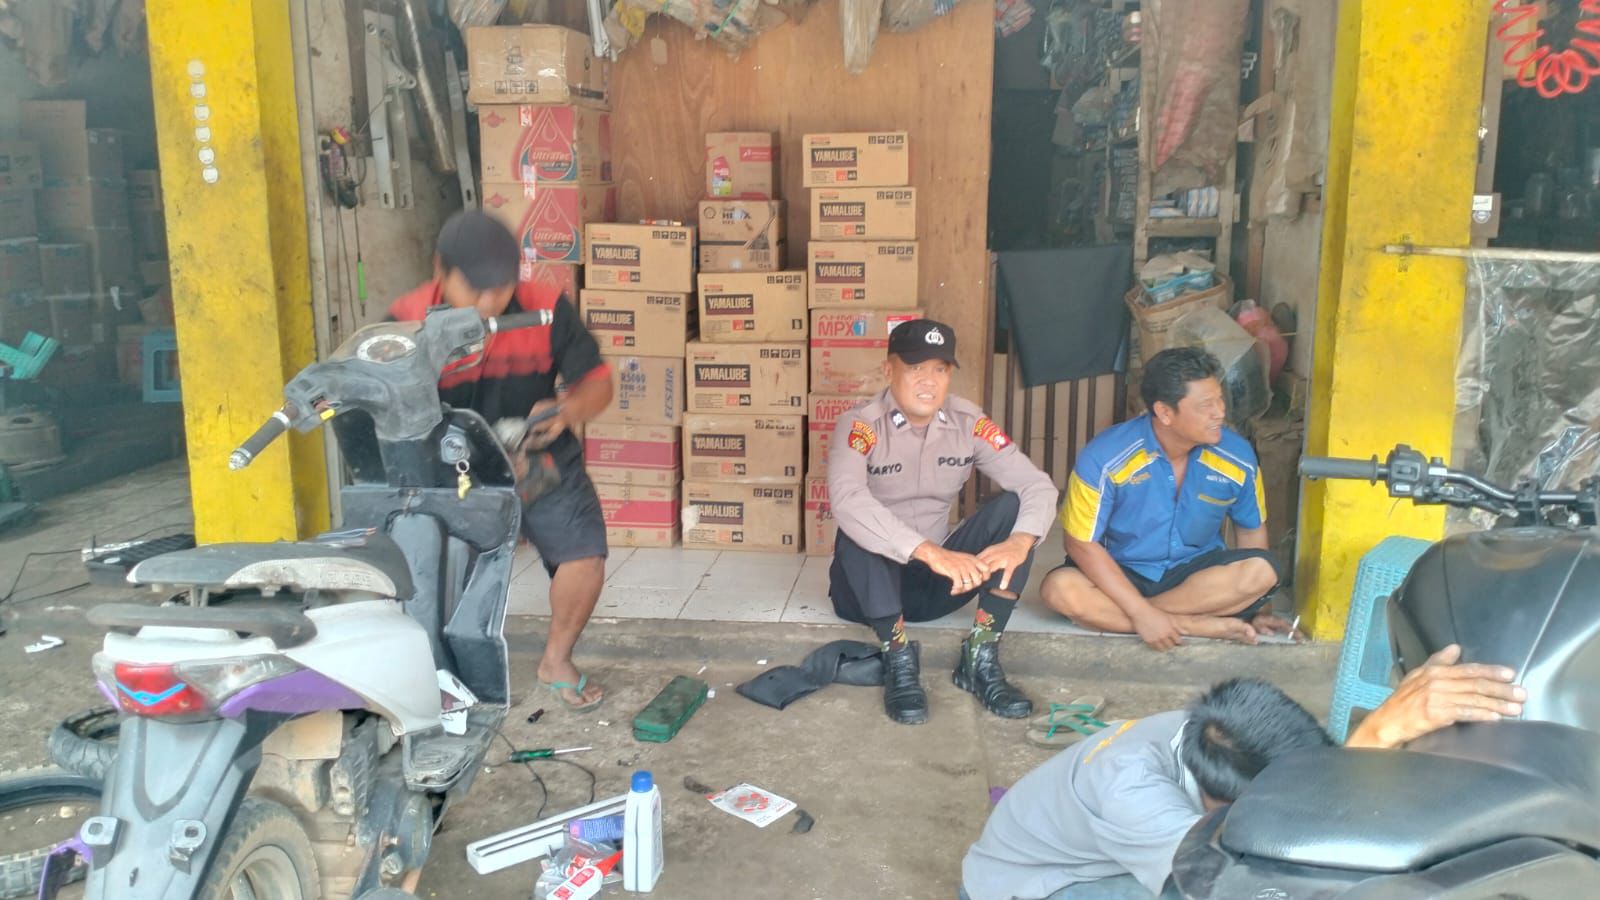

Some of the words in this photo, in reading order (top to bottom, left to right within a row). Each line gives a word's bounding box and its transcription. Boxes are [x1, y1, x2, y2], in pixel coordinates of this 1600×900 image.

[815, 150, 854, 162] YAMALUBE
[822, 205, 863, 216] YAMALUBE
[595, 248, 639, 260] YAMALUBE
[818, 265, 863, 277] YAMALUBE
[708, 297, 752, 309] YAMALUBE
[590, 311, 633, 324] YAMALUBE
[699, 368, 748, 381] YAMALUBE
[694, 437, 744, 450] YAMALUBE
[698, 504, 741, 518] AMALUBE
